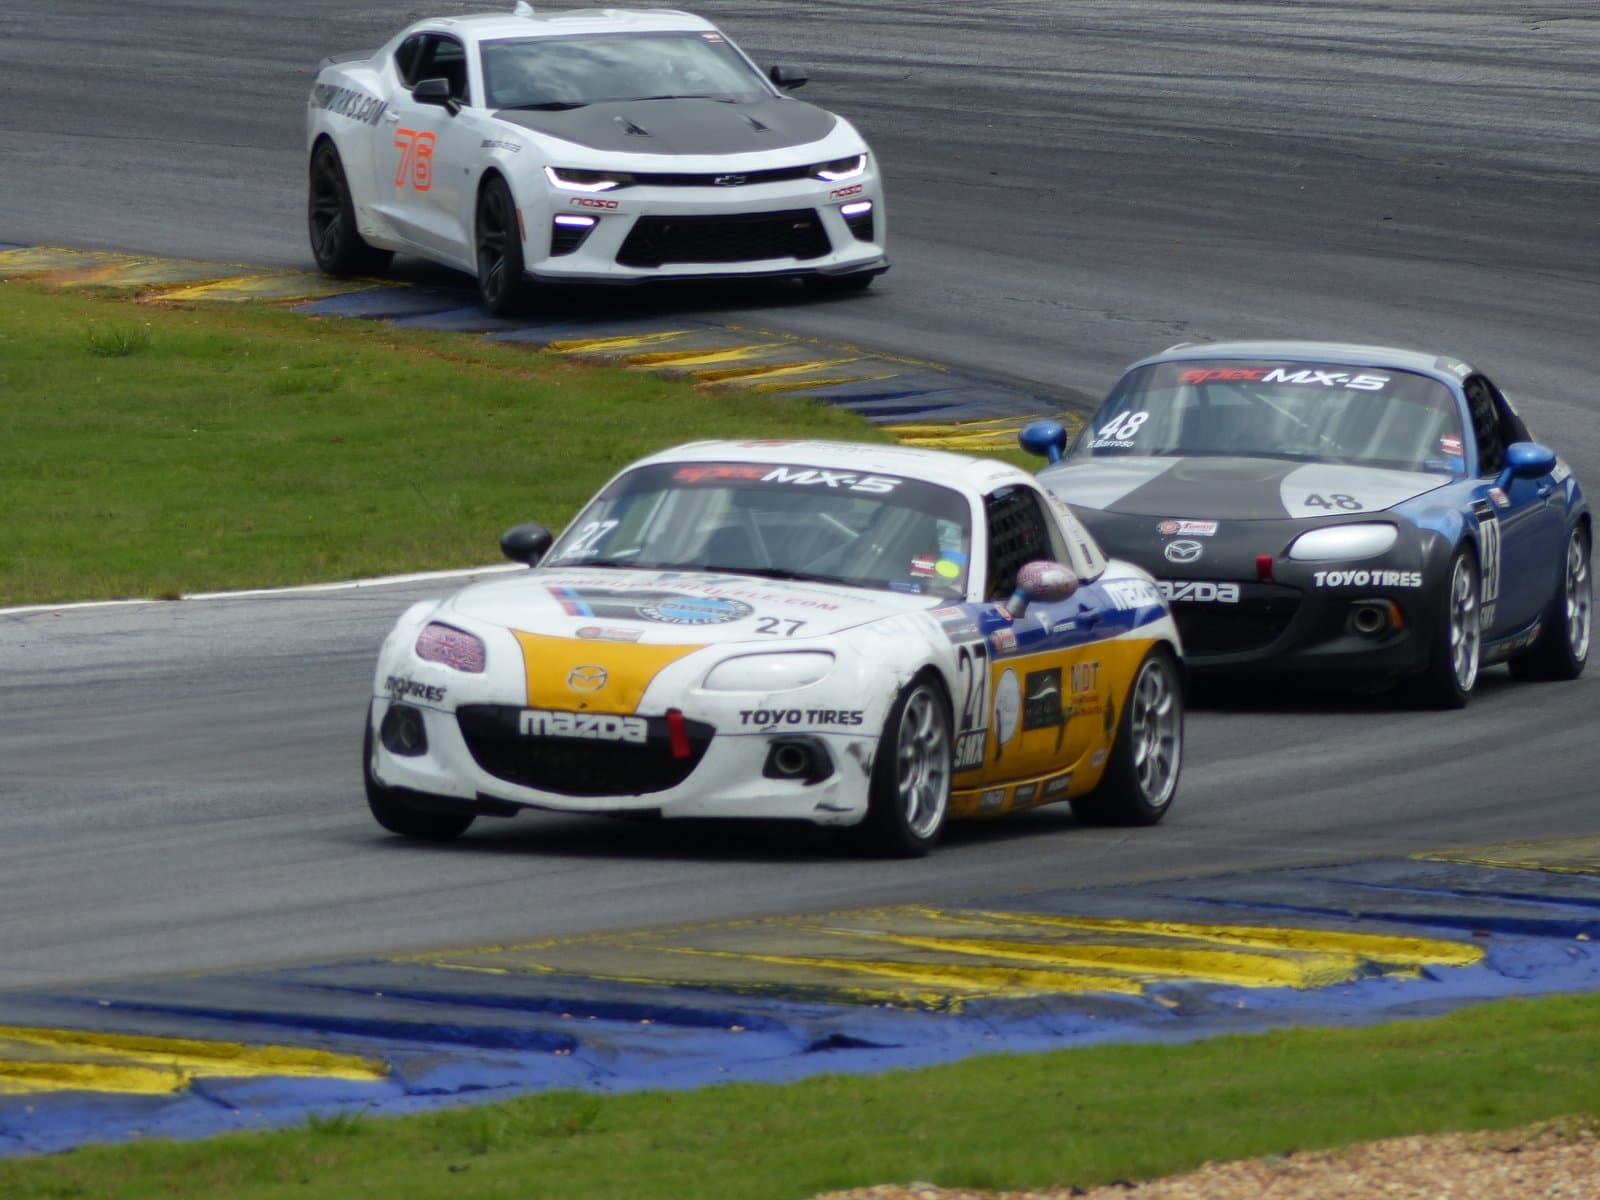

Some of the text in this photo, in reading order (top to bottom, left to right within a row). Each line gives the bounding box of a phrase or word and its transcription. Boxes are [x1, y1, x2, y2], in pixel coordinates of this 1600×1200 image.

[1261, 368, 1390, 391] MX-5
[1098, 411, 1149, 440] 48
[760, 467, 902, 494] MX-5
[1304, 494, 1362, 511] 48
[1313, 570, 1422, 587] TOYO TIRES
[1156, 581, 1239, 603] azda
[755, 616, 808, 637] 27
[958, 644, 987, 731] 27
[739, 709, 864, 725] TOYO TIRES
